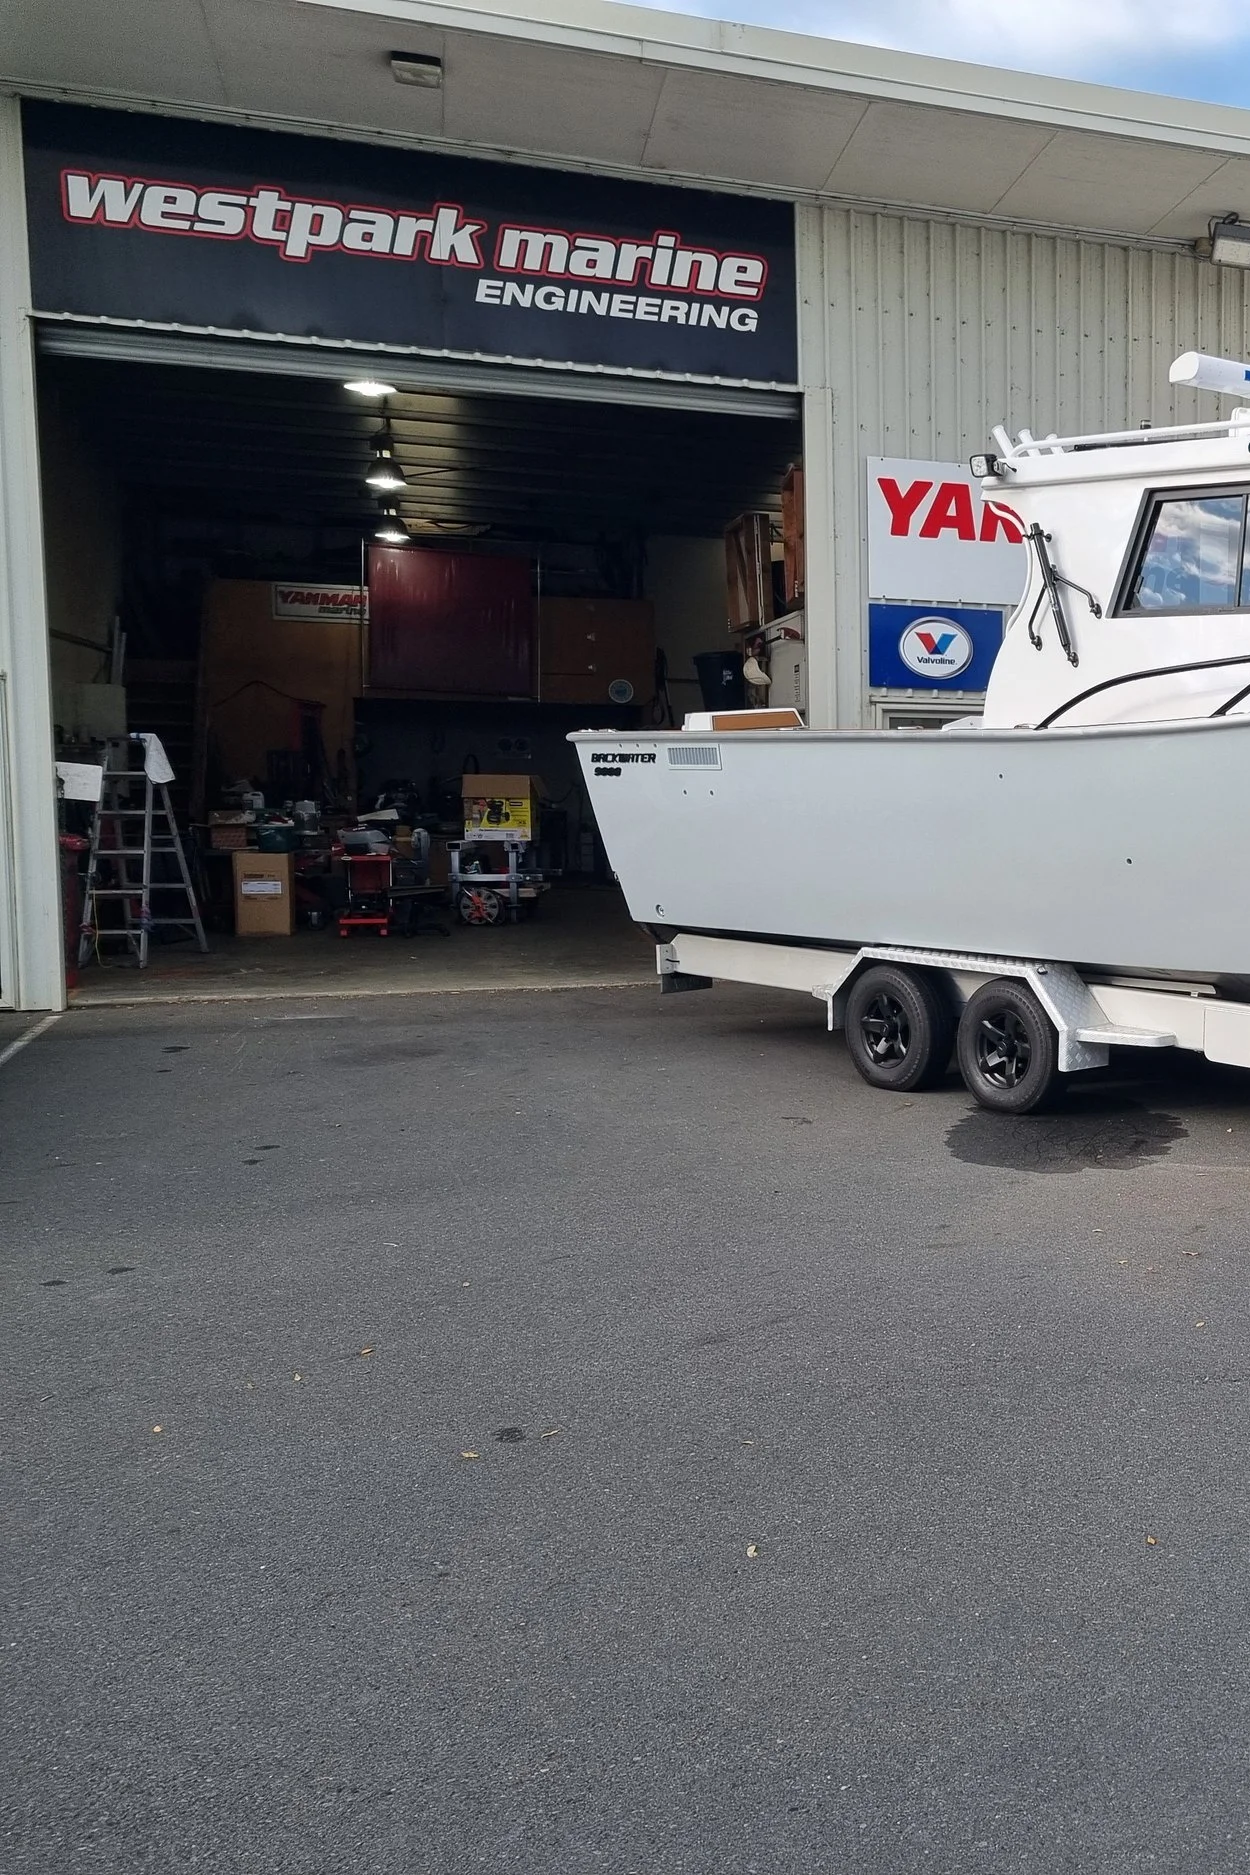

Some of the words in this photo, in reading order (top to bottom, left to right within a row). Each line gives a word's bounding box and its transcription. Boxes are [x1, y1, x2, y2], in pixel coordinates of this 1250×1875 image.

[63, 171, 484, 266] westpark
[497, 231, 766, 299] marine
[475, 278, 759, 332] ENGINEERING
[279, 590, 367, 607] YANMAR
[916, 656, 957, 666] Valvoline
[591, 753, 657, 764] BACKWATER
